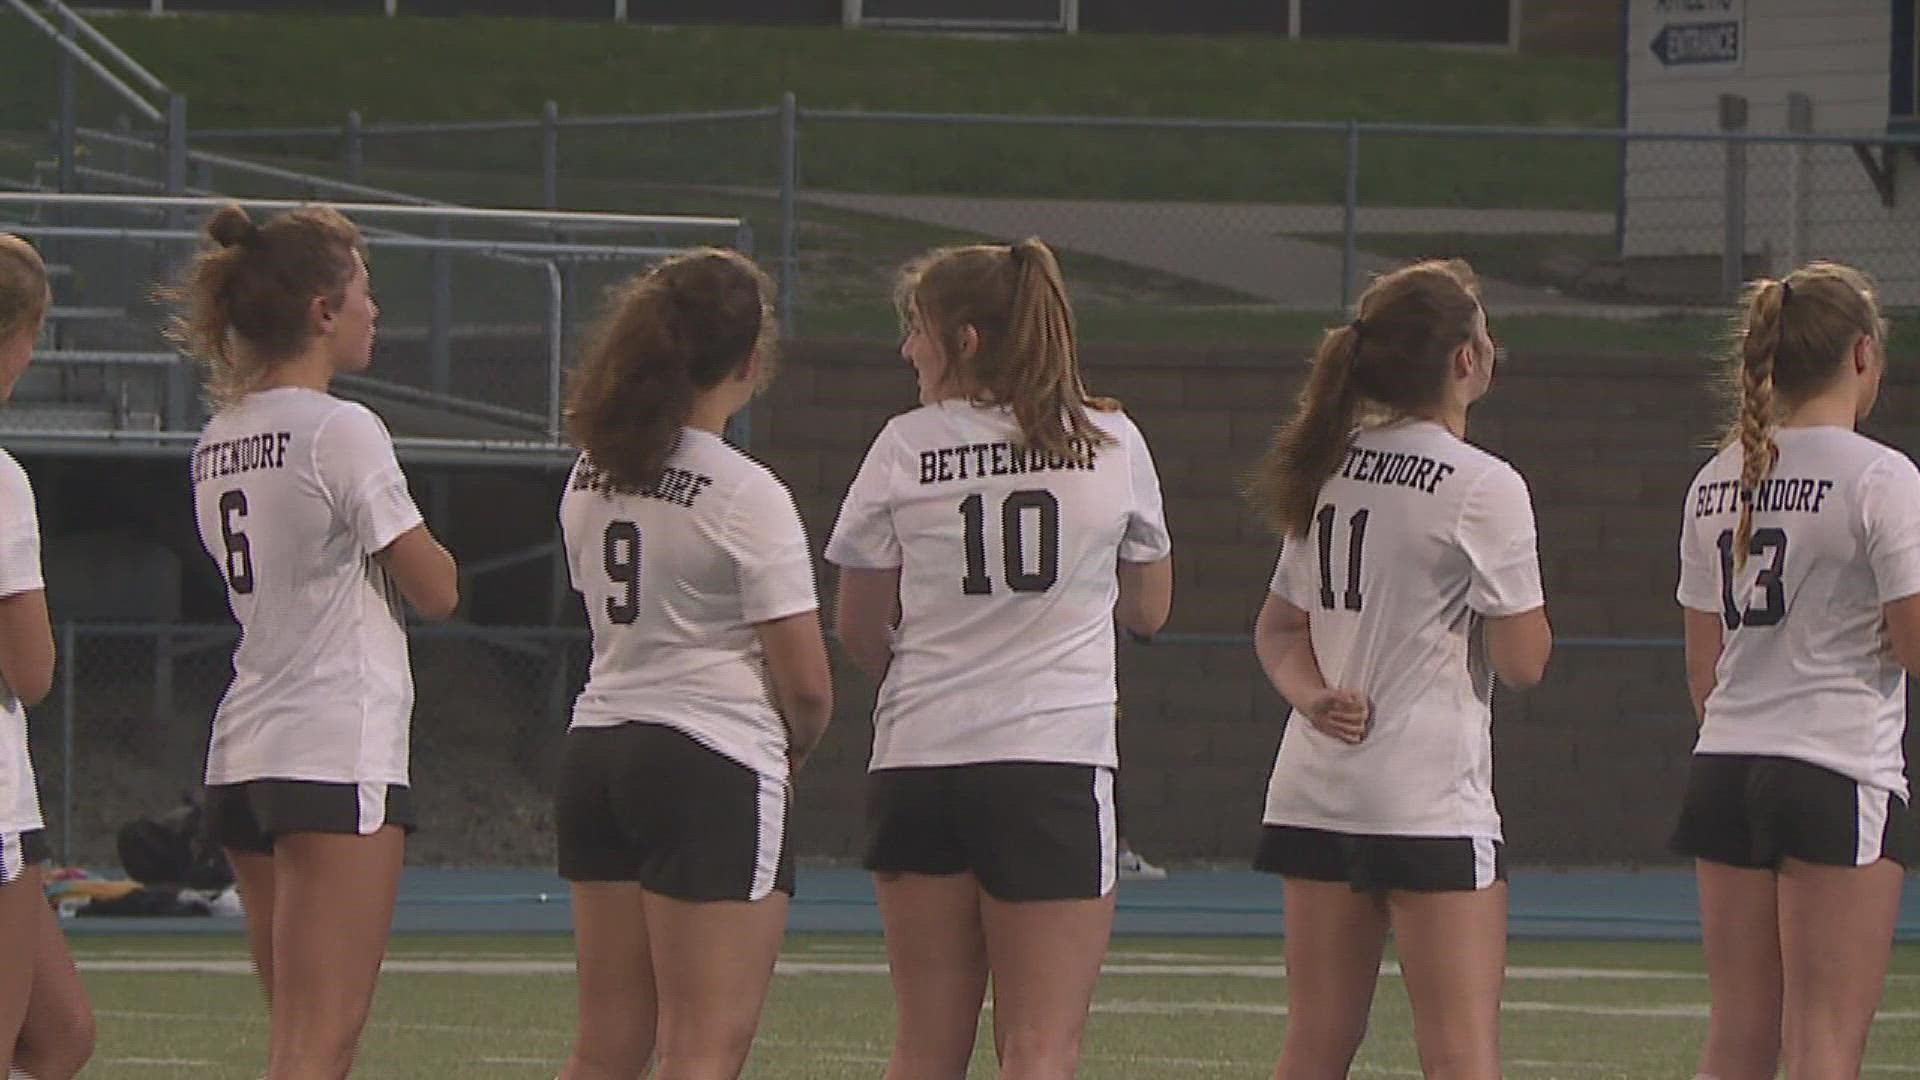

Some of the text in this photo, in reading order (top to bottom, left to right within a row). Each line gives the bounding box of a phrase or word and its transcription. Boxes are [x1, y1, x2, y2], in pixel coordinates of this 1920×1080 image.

[1667, 26, 1735, 58] ENTRANCE
[219, 488, 253, 594] 6
[959, 489, 1059, 595] 10
[1695, 479, 1833, 518] BETTNDORF
[603, 519, 640, 624] 9
[1317, 503, 1369, 612] 11
[1717, 527, 1787, 630] 13
